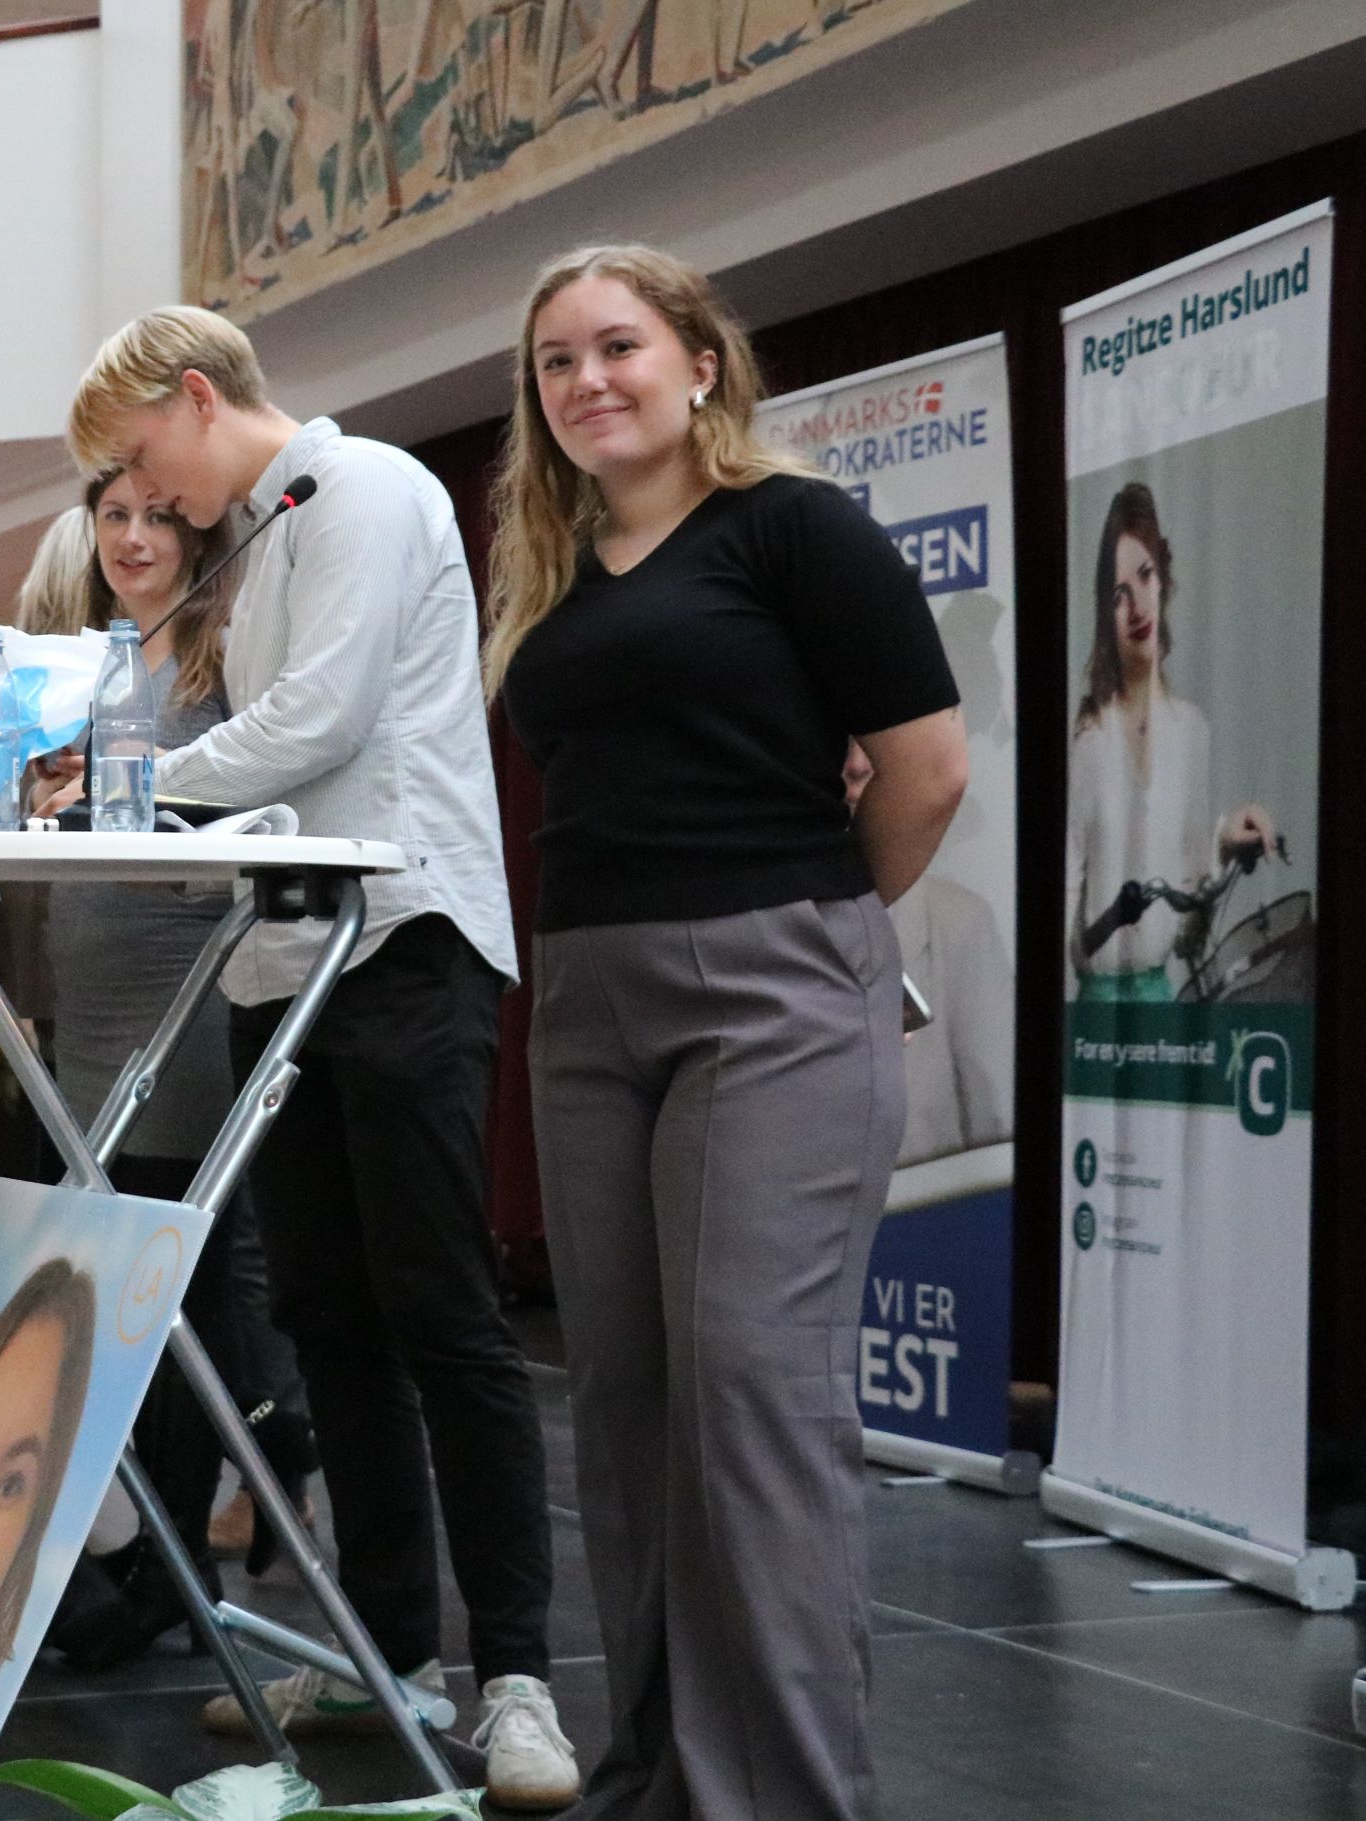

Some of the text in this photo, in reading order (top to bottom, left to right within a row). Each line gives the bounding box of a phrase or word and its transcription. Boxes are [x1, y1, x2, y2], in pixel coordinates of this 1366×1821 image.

[1082, 246, 1311, 378] Regitze Harslund
[816, 407, 988, 479] OKRATERNE
[892, 519, 981, 584] SEN
[1248, 1055, 1276, 1116] C
[873, 1277, 956, 1333] VI ER
